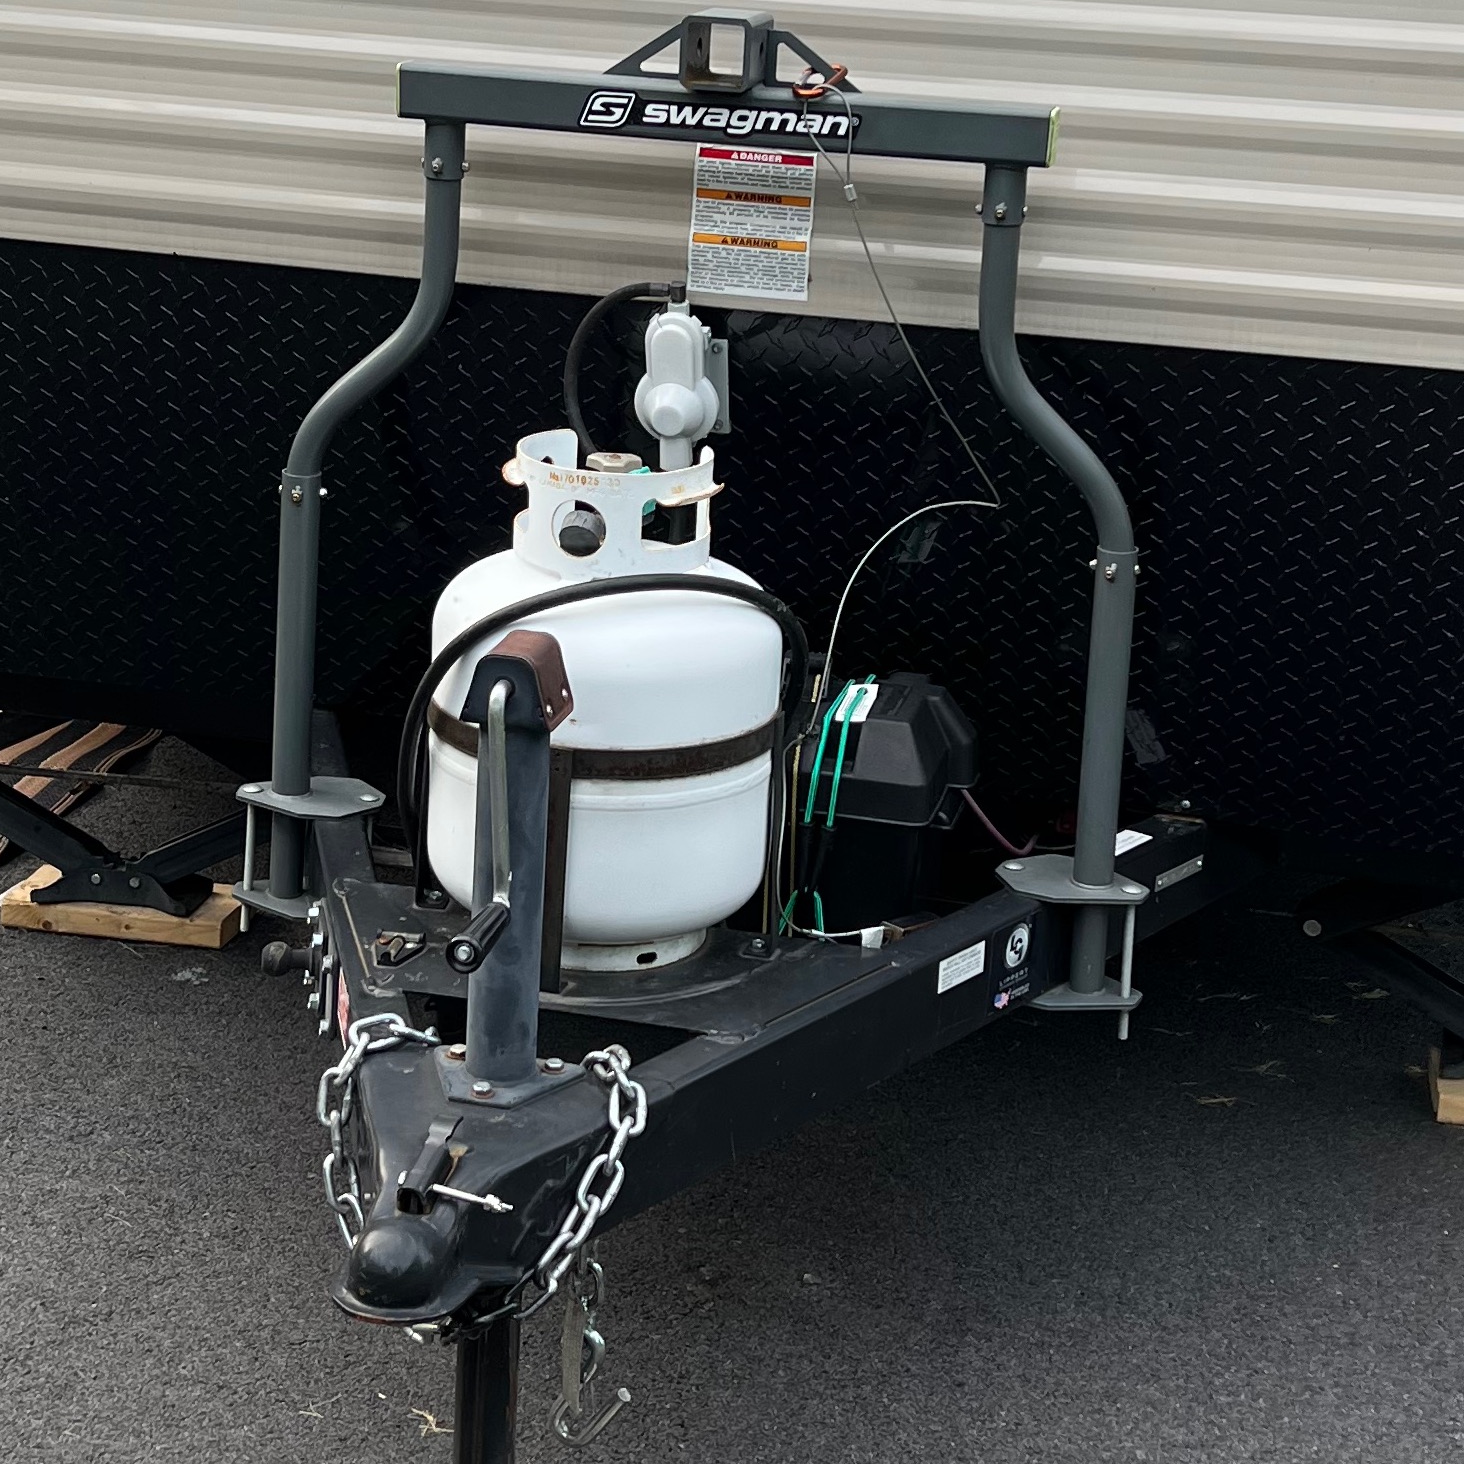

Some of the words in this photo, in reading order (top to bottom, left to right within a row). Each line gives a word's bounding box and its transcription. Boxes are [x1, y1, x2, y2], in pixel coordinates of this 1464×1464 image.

[642, 103, 850, 135] swagman
[739, 152, 783, 163] DANGER
[735, 192, 783, 204] WARNING
[730, 237, 778, 249] WARNING
